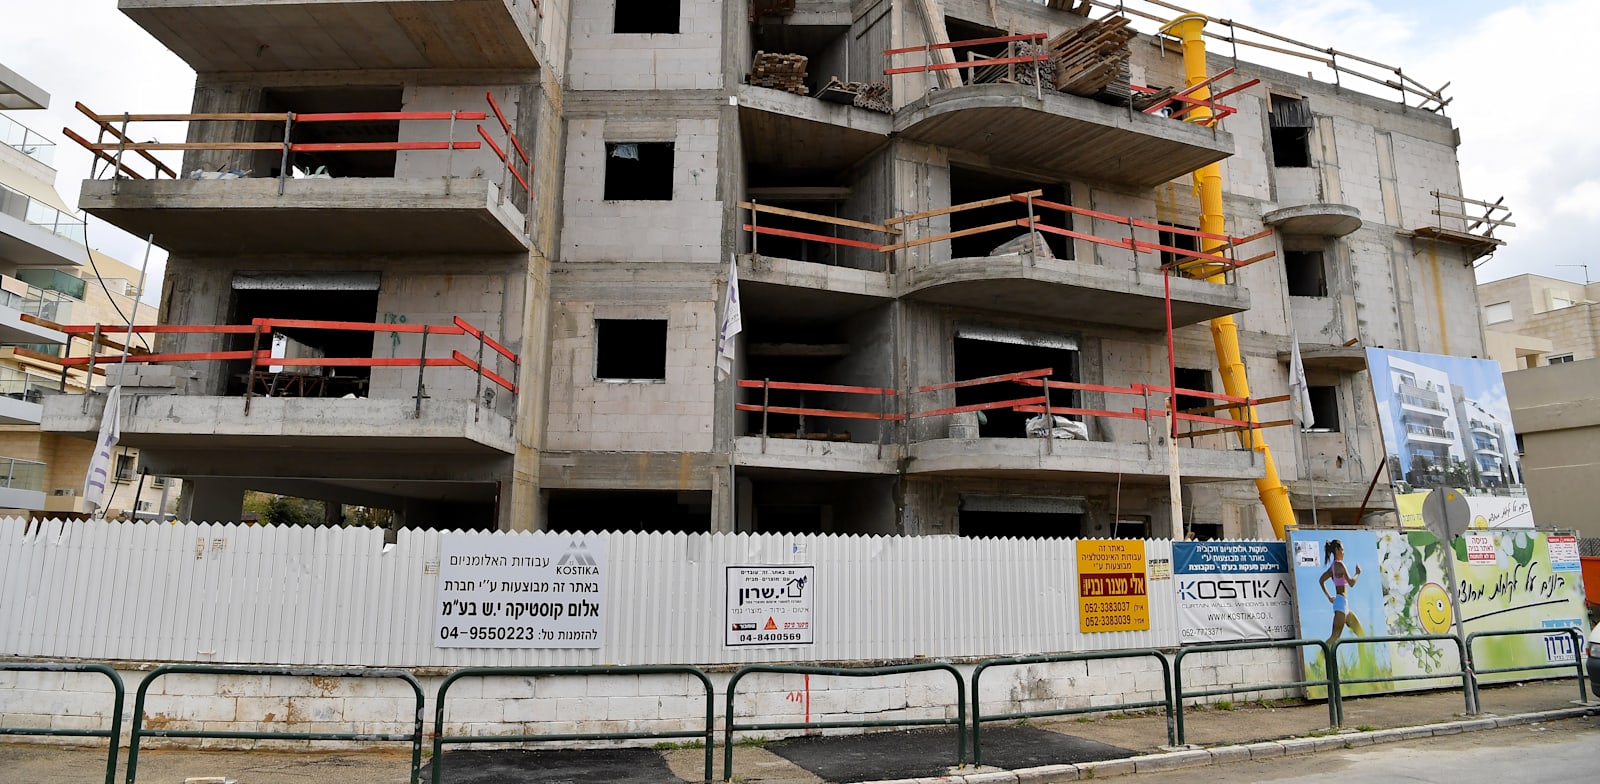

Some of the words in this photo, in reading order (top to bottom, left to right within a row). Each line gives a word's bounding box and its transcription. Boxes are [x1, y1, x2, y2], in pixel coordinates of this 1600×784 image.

[450, 554, 507, 567] האלומניום
[512, 556, 550, 568] עבודות
[1081, 553, 1120, 561] האינסטלציה
[1240, 554, 1247, 562] זה
[1249, 554, 1265, 562] באתר
[556, 566, 599, 575] KOSTIKA
[1093, 562, 1103, 570] ע"י
[1106, 562, 1131, 570] מבוצעות
[1525, 561, 1538, 592] על
[444, 580, 475, 592] חברת
[501, 581, 549, 593] מבוצעות
[553, 582, 566, 593] זה
[569, 582, 599, 593] באתר
[1130, 573, 1145, 594] אלי
[1488, 563, 1521, 603] לקוחות
[1541, 574, 1565, 598] בונים
[1180, 580, 1292, 600] KOSTIKA
[1458, 579, 1485, 603] מרוצי
[739, 587, 785, 607] י.שרון
[441, 600, 477, 616] בע"מ
[482, 602, 501, 617] י.ש
[505, 602, 564, 620] קוסטיקה
[568, 599, 599, 617] אלום
[1084, 601, 1130, 613] 052-3383037
[1085, 614, 1131, 627] 052-3383039
[440, 626, 534, 641] 04-9550223
[538, 628, 554, 640] טל:
[558, 628, 598, 640] להזמנות
[740, 633, 801, 641] 04-8400569
